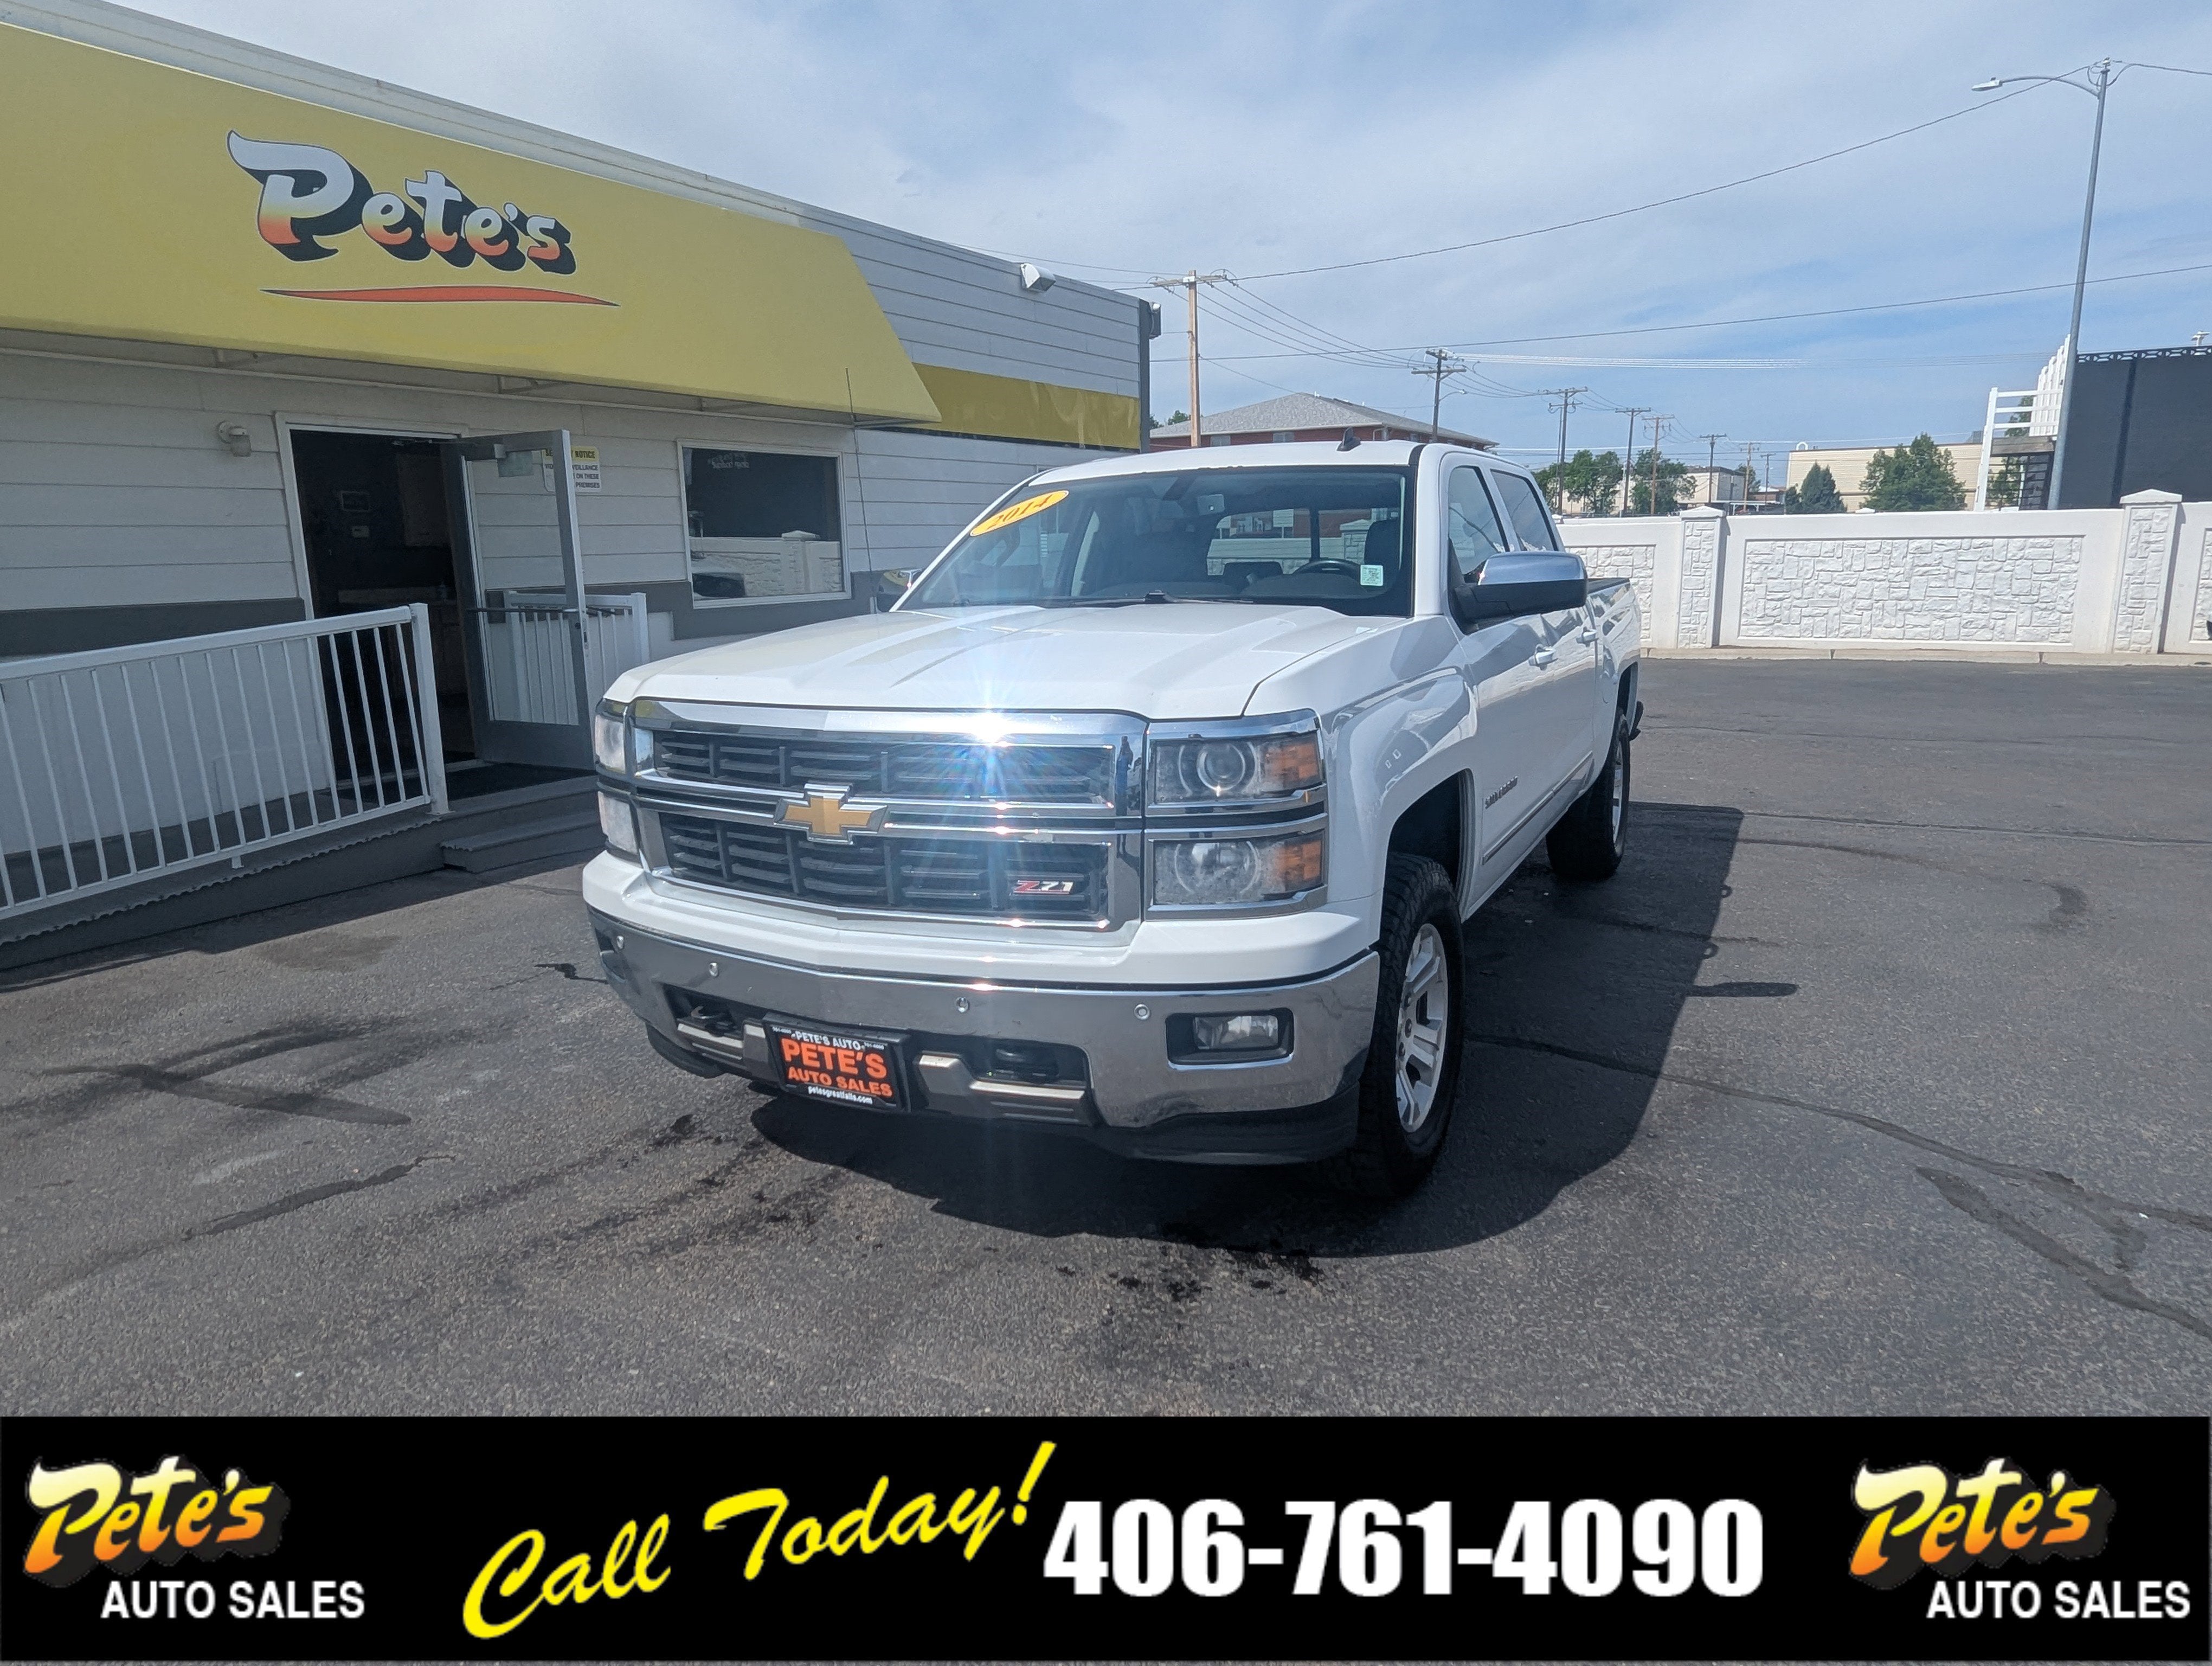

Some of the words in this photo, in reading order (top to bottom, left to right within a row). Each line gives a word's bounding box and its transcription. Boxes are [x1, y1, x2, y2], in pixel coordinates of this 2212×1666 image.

[227, 129, 576, 275] Pete's
[575, 450, 595, 459] NOTICE
[987, 495, 1053, 530] 2014
[1013, 880, 1074, 895] Z71
[795, 1031, 831, 1046] PETE'S
[832, 1037, 861, 1050] AUTO
[781, 1037, 888, 1079] PETE'S
[788, 1066, 832, 1086] AUTO
[835, 1076, 893, 1098] SALES
